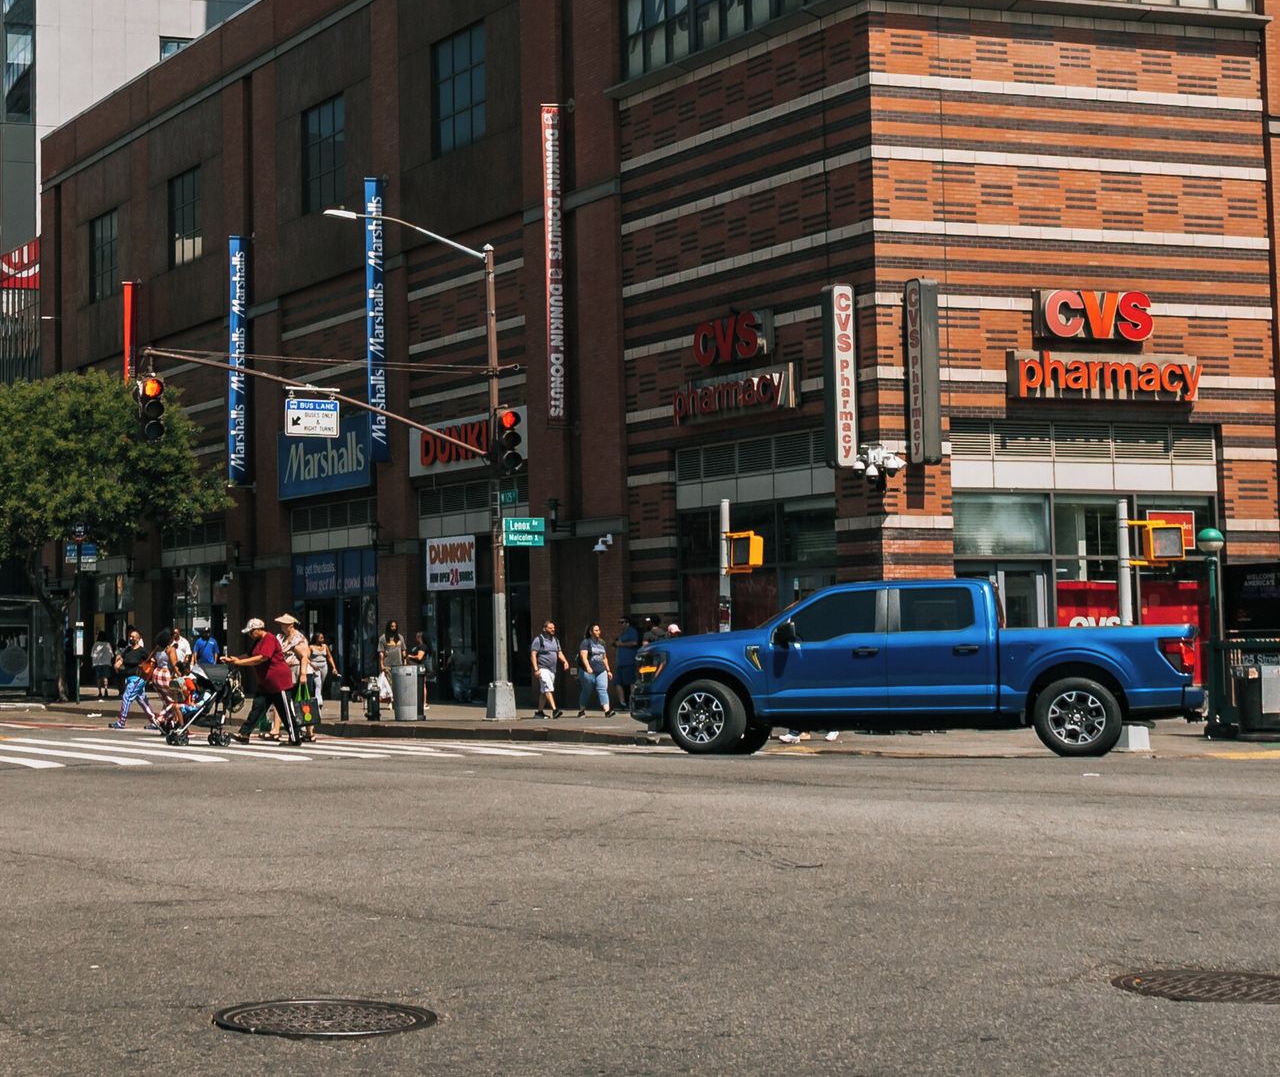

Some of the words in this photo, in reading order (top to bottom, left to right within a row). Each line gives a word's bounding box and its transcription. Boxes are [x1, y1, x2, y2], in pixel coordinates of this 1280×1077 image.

[545, 129, 560, 195] DUNKIN'
[547, 197, 562, 260] DONUTS
[232, 250, 246, 318] Marshalls
[370, 282, 385, 358] Marshalls
[550, 284, 564, 351] DUNKIN'
[693, 311, 758, 367] CVS
[835, 292, 852, 353] CVS
[908, 288, 920, 349] CVS
[1045, 289, 1155, 342] CVS
[550, 353, 564, 417] DONUTS
[673, 371, 784, 426] pharmacy
[911, 355, 922, 456] pharmacy
[1020, 350, 1204, 400] pharmacy
[230, 403, 246, 472] Marshalls
[839, 359, 854, 459] pharmacy
[284, 431, 365, 484] Marshalls
[421, 419, 488, 466] DUNKI
[429, 541, 474, 565] DUNKIN'
[510, 520, 530, 530] Lenox
[450, 569, 460, 586] 24
